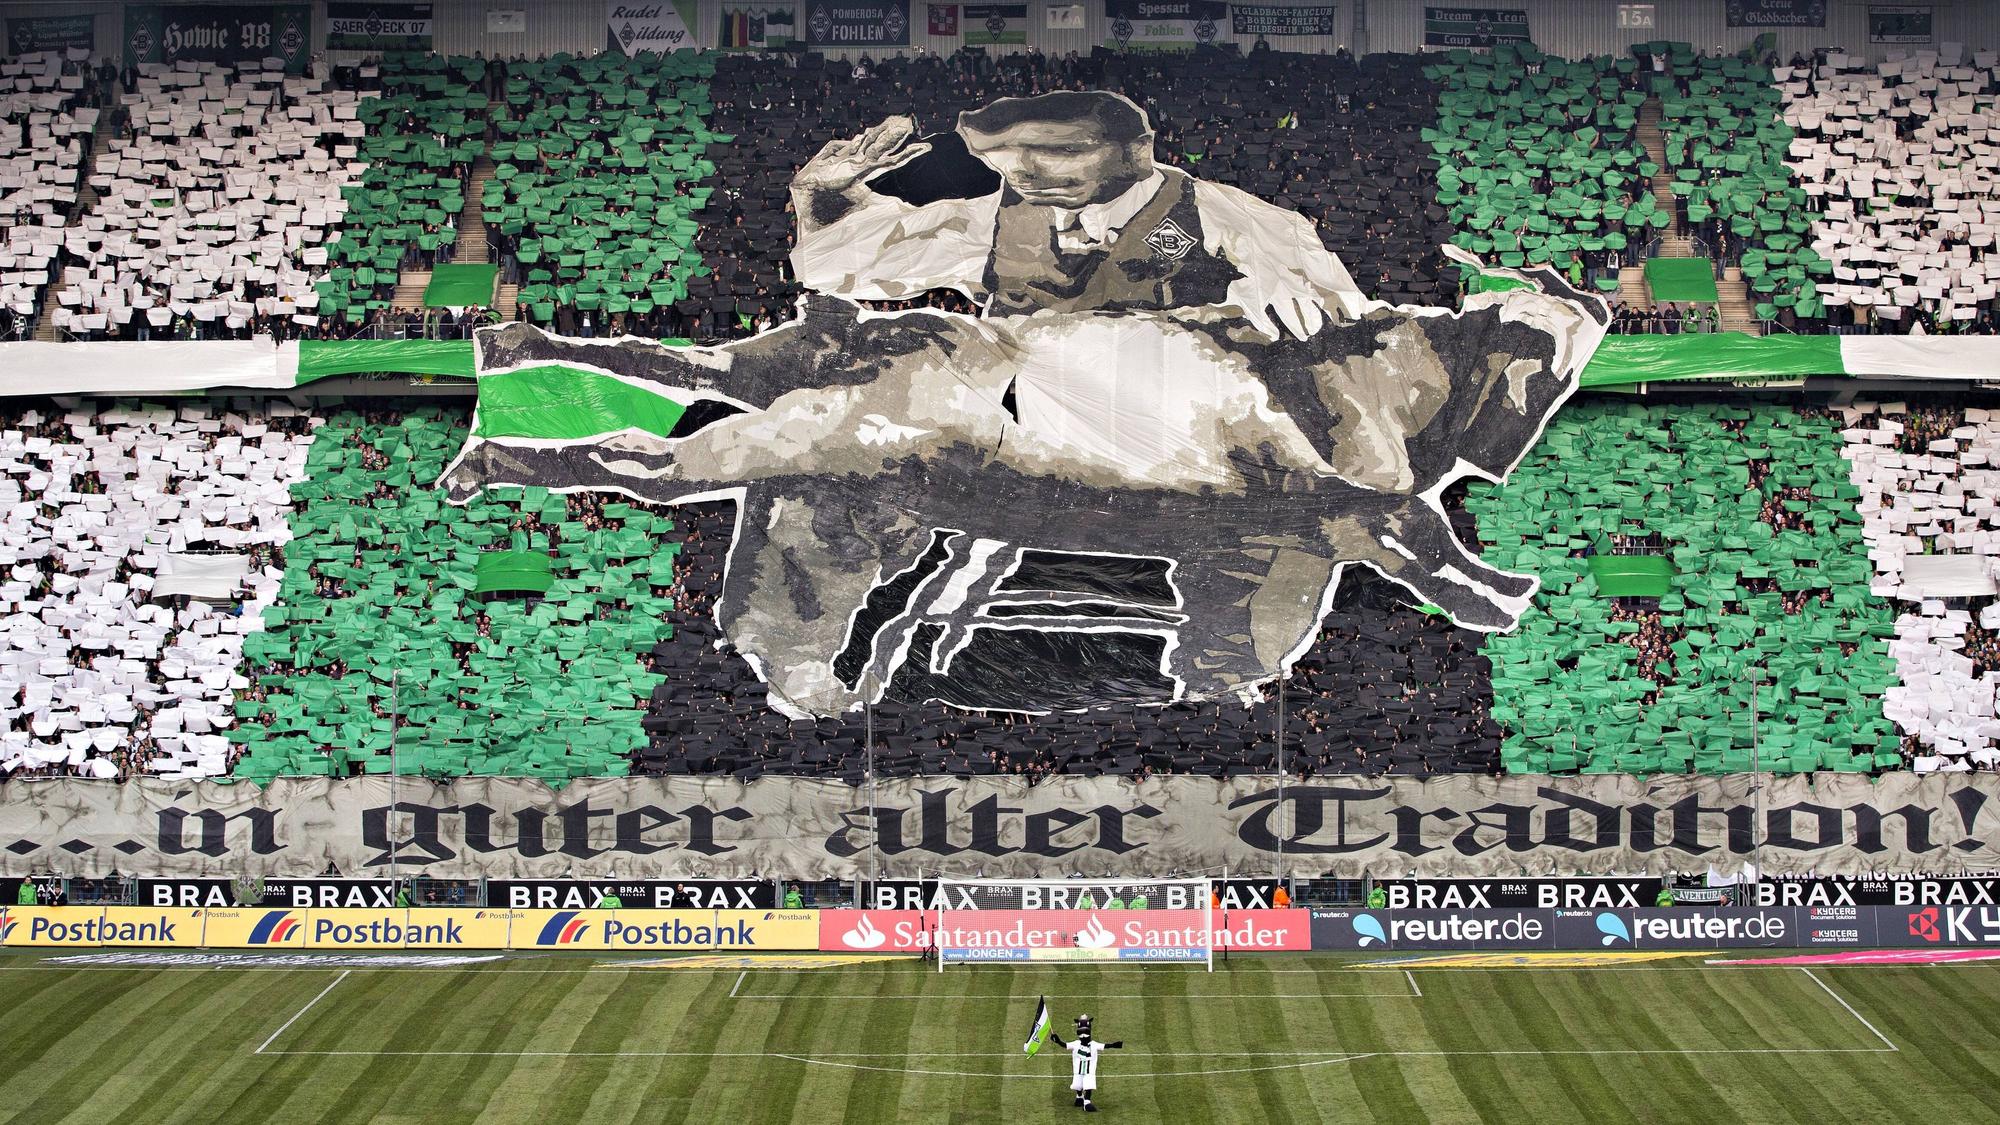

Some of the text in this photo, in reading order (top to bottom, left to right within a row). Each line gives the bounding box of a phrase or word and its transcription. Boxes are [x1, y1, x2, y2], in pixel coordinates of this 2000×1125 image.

[612, 5, 663, 18] Rudel
[832, 8, 883, 19] PONDEROSA
[1138, 3, 1190, 16] Spessart
[1435, 10, 1472, 21] Dream
[1620, 10, 1652, 26] 15A
[1745, 11, 1808, 25] Gladbacher
[163, 21, 228, 57] Howie
[832, 24, 884, 40] FOHLEN
[1145, 25, 1183, 36] Fohlen
[1247, 25, 1319, 34] HILDESHEIM 1994
[363, 798, 753, 867] guter
[825, 787, 1164, 857] alter
[1228, 786, 1987, 857] Tradition!
[293, 885, 393, 907] BRAX
[876, 886, 979, 910] BRAX
[1389, 885, 1491, 908] BRAX
[1538, 884, 1640, 908] BRAX
[1758, 883, 1856, 906] BRAX
[1894, 881, 1995, 905] BRAX
[31, 915, 177, 942] Postbank
[778, 913, 812, 921] Postbank
[1391, 913, 1543, 941] reuter.de
[1635, 911, 1785, 939] reuter.de
[315, 917, 463, 944] Postbank
[604, 918, 755, 945] Postbank
[894, 920, 1057, 948] Santander
[1124, 918, 1287, 947] Santander
[965, 948, 1013, 959] JONGEN
[1144, 948, 1191, 958] JONGEN
